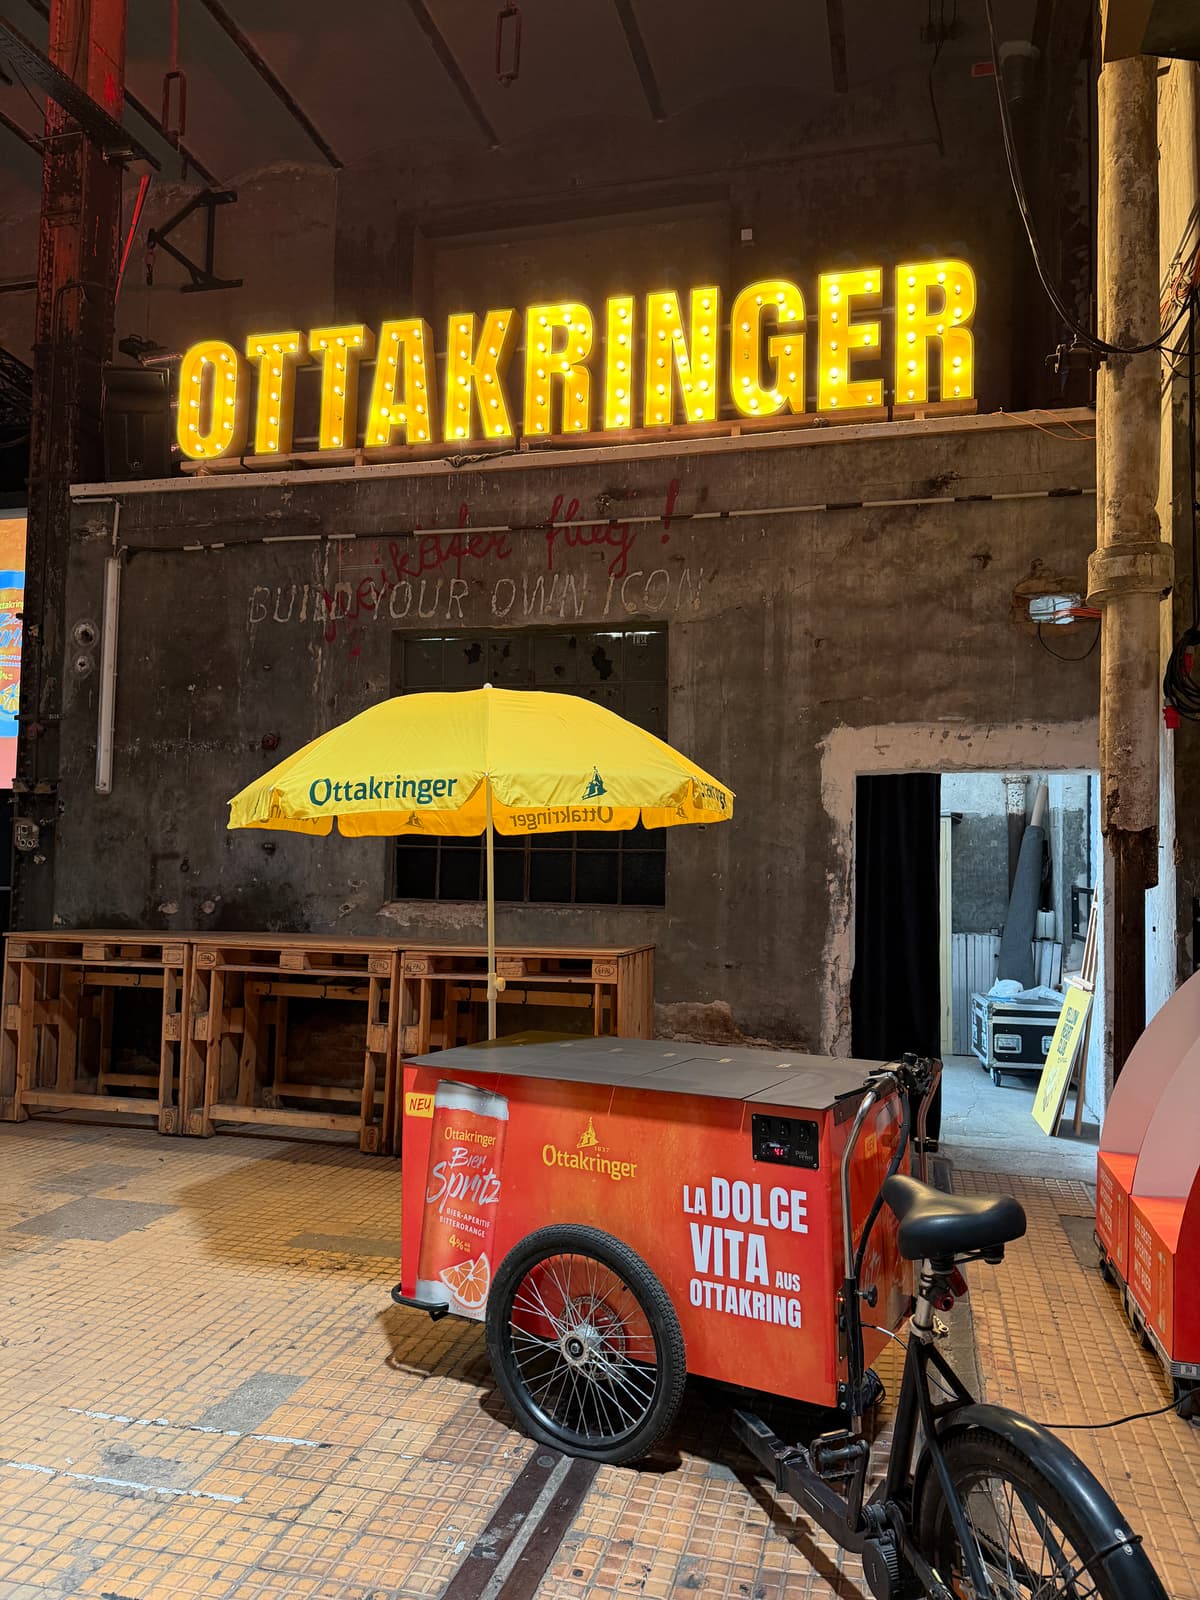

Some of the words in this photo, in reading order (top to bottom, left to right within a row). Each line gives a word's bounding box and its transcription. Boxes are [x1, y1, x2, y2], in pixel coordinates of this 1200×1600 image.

[175, 257, 978, 461] OTTAKRINGER
[368, 578, 470, 621] YOUR
[491, 573, 588, 618] OWN
[601, 566, 705, 618] ICON
[309, 774, 458, 807] Ottakringer
[409, 1097, 432, 1112] NEU
[444, 1126, 497, 1148] Ottakringer
[448, 1147, 488, 1169] Bier
[542, 1144, 638, 1181] Ottakringer
[426, 1161, 502, 1214] Spritz
[683, 1184, 707, 1216] LA
[711, 1176, 809, 1234] DOLCE
[439, 1215, 486, 1239] BITTERORANGE
[448, 1233, 464, 1252] 4%
[689, 1222, 770, 1287] VITA
[775, 1270, 801, 1292] AUS
[689, 1278, 802, 1329] OTTAKRING
